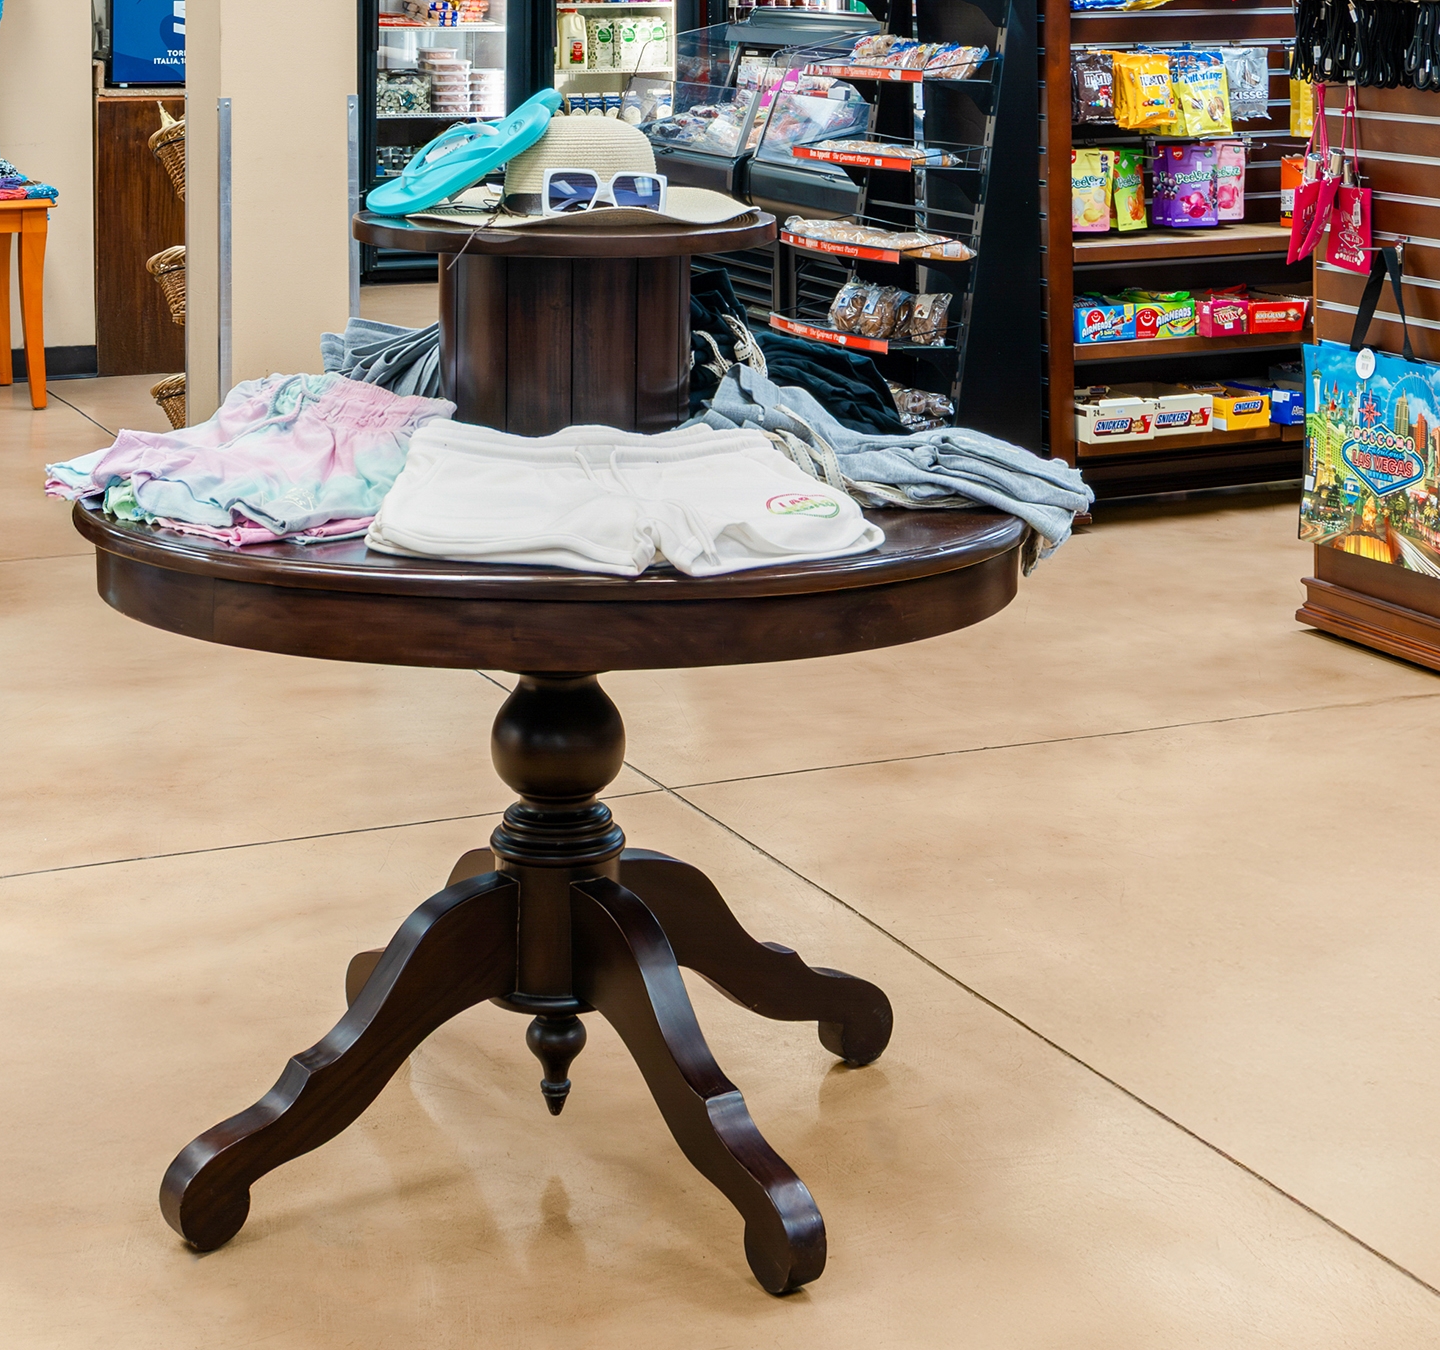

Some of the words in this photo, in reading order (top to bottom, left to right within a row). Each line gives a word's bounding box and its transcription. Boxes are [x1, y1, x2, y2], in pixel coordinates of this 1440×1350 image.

[1230, 89, 1269, 100] KISSES
[817, 150, 830, 159] Appetit
[839, 154, 856, 163] Gourmet
[857, 156, 871, 166] Pastry
[1175, 171, 1211, 184] Peelerz
[1216, 166, 1241, 178] eelerz
[805, 238, 819, 249] Appetit
[827, 243, 844, 253] Gourmet
[844, 245, 858, 256] Pastry
[1156, 307, 1192, 328] AIRHEADS
[1214, 311, 1239, 324] TWIX
[1268, 311, 1286, 319] GRAND
[1082, 321, 1112, 338] AIRHEADS
[1234, 400, 1260, 413] SNICKERS
[1157, 412, 1189, 425] SNICKERS
[1096, 419, 1129, 432] SNICKERS
[1353, 427, 1414, 452] WELCOME
[1352, 449, 1371, 469] LAS
[1374, 454, 1413, 478] VEGAS
